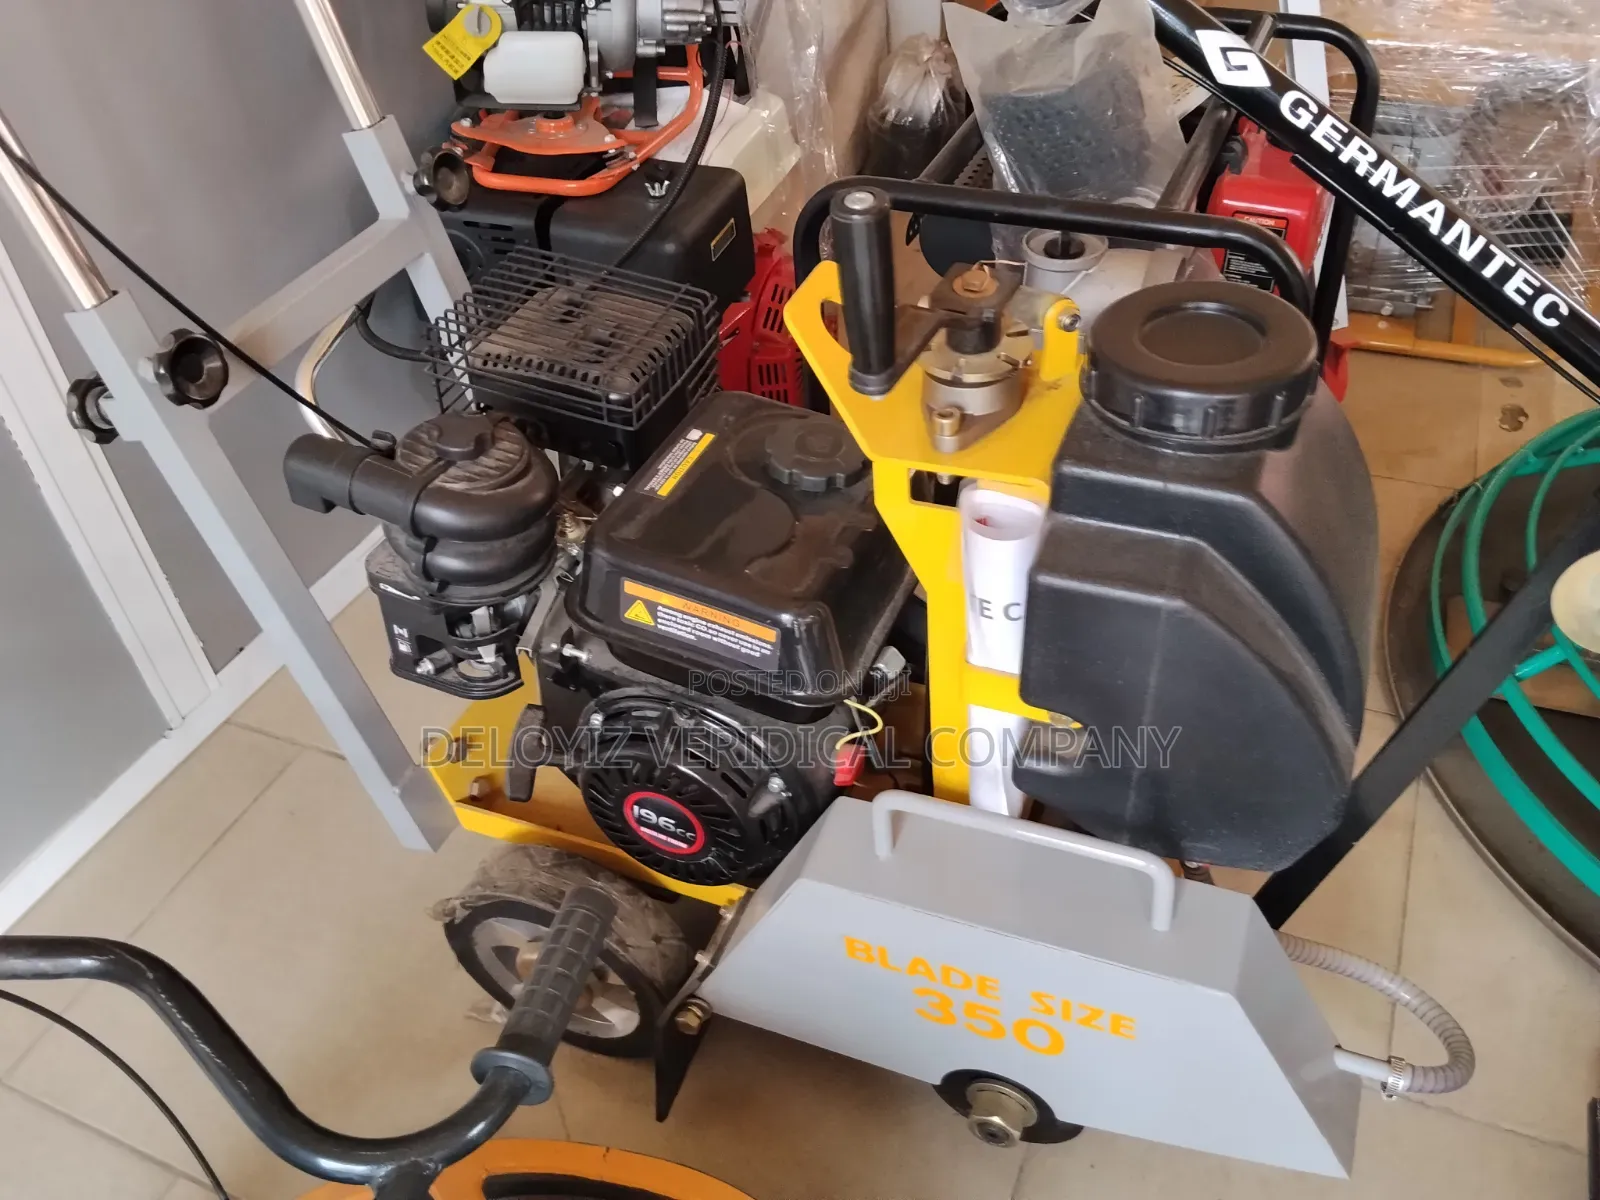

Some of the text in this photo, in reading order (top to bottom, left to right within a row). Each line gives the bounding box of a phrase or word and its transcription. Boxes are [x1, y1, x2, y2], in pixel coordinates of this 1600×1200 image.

[1280, 91, 1569, 326] GERMANTEC
[683, 602, 740, 628] WARNING
[971, 593, 1022, 621] EC
[741, 646, 760, 658] good
[633, 805, 696, 840] 196cc
[844, 935, 1136, 1040] BLADE SIZE
[912, 987, 1065, 1056] 350
